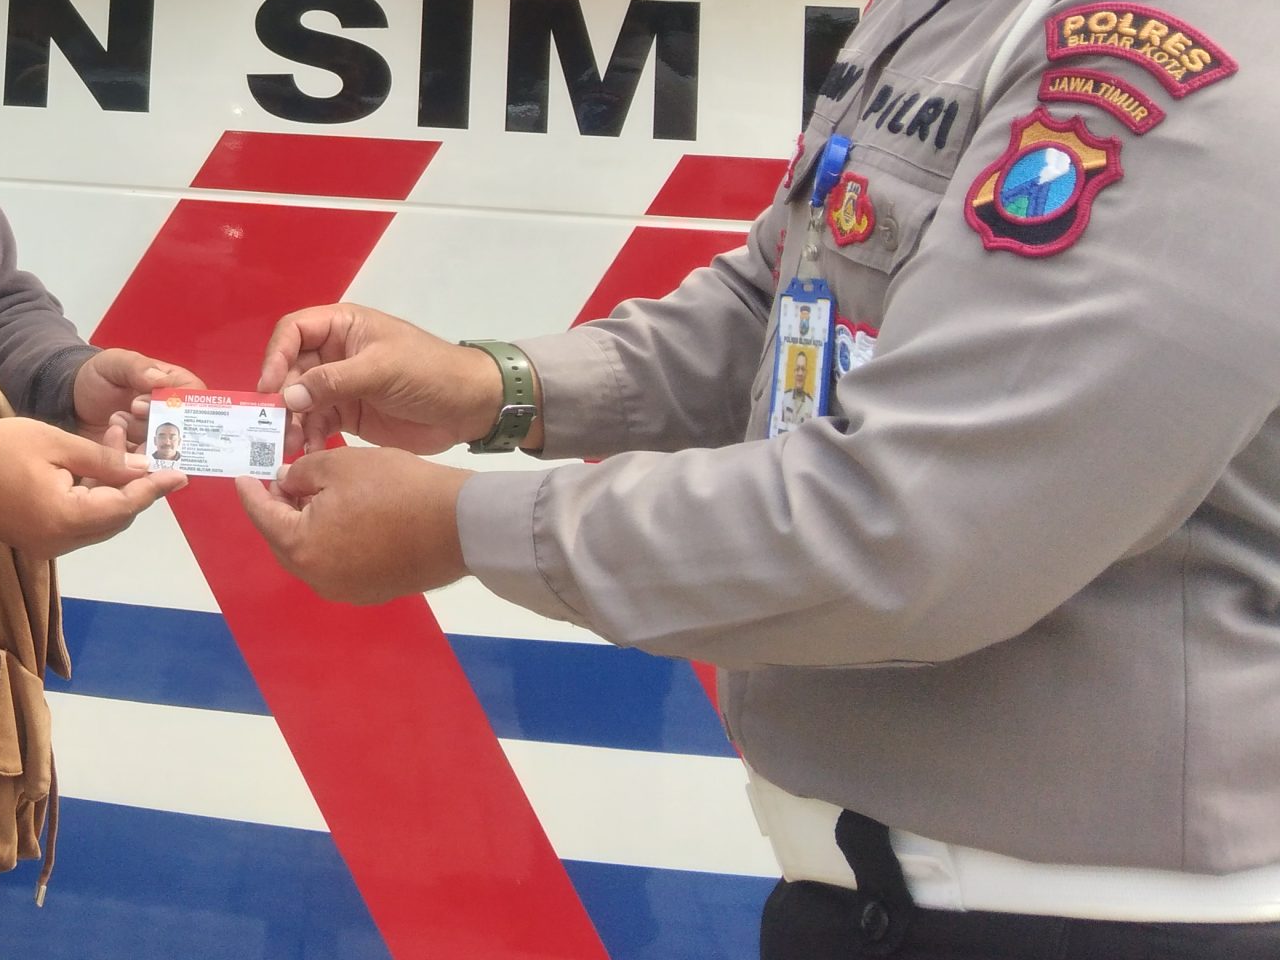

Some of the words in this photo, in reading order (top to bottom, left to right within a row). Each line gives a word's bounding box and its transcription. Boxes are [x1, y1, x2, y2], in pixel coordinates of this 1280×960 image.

[1063, 11, 1212, 73] POLRES
[1067, 32, 1135, 50] BLITAR
[1137, 42, 1187, 81] KOTA
[1049, 76, 1094, 95] JAWA
[1096, 82, 1149, 122] TIMUR
[184, 394, 232, 404] INDONESIA
[259, 408, 267, 417] A
